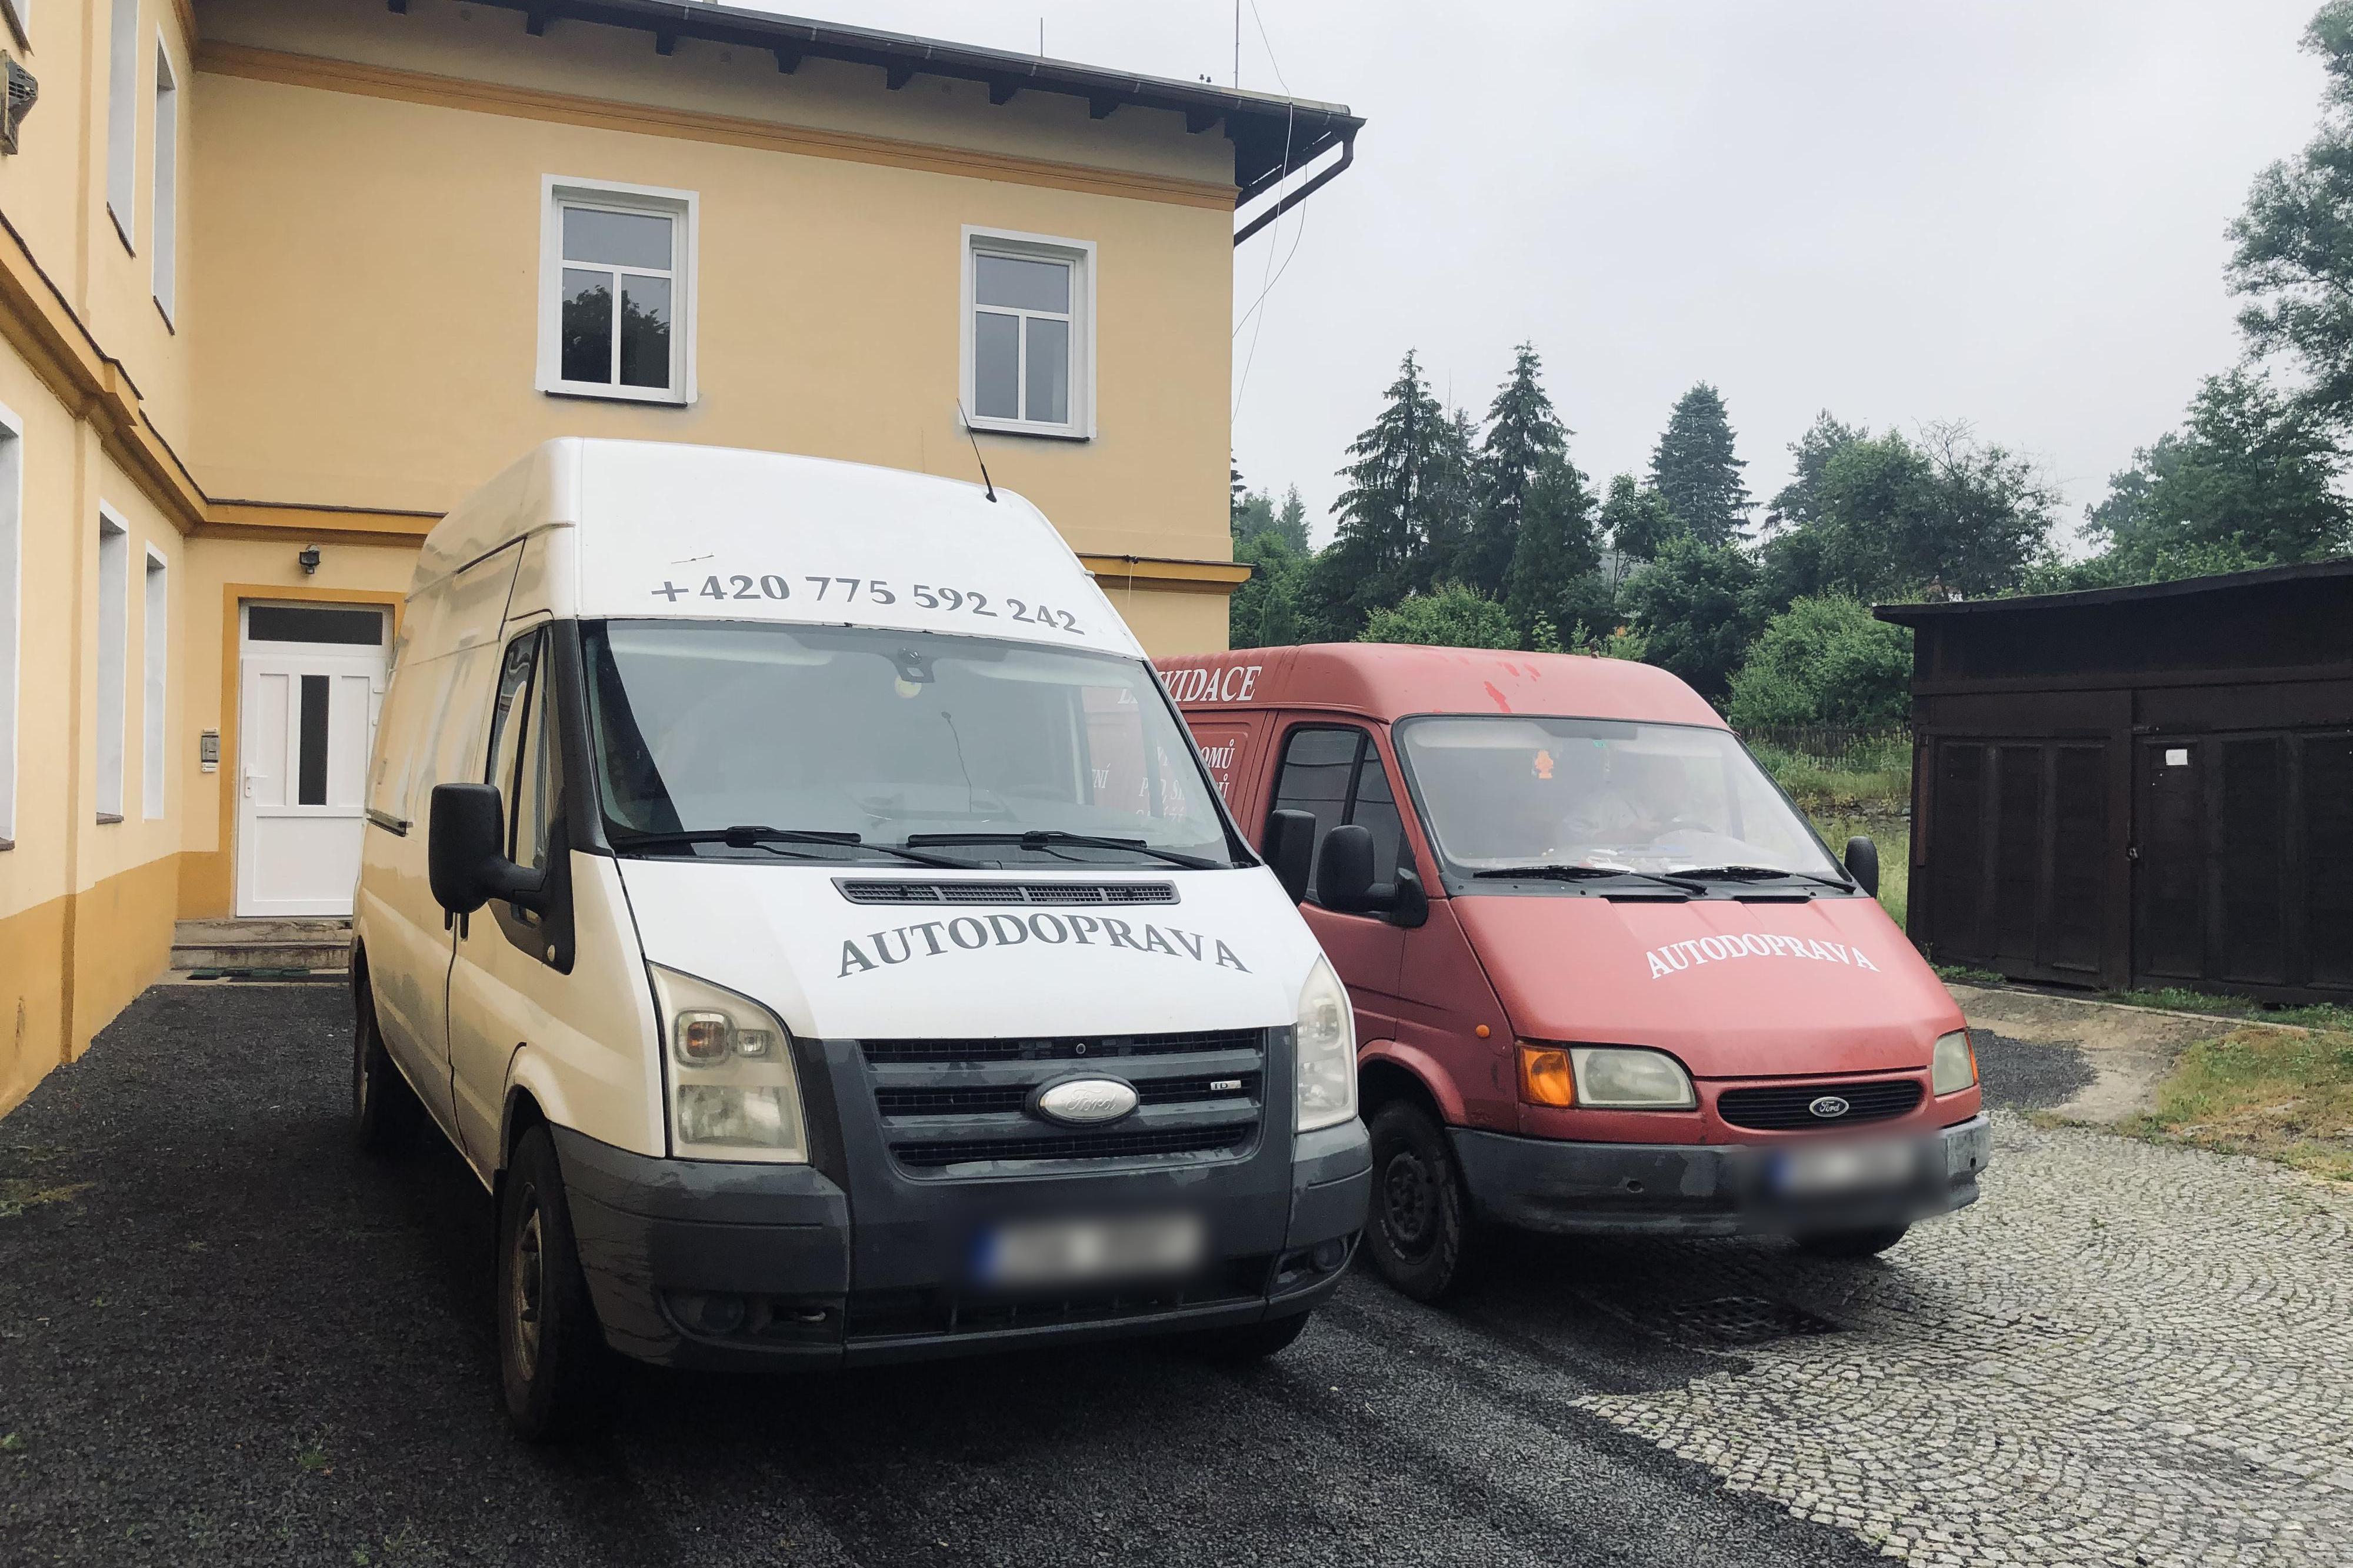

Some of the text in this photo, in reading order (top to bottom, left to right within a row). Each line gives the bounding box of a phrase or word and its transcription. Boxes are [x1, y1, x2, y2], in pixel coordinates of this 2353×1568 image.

[805, 576, 896, 605] 775
[913, 584, 998, 618] 592
[1006, 598, 1085, 635] 242
[1201, 738, 1235, 769] OMŮ
[837, 913, 1252, 979] AUTODOPRAVA
[1646, 933, 1881, 979] AUTODOPRAVA
[1065, 1089, 1117, 1111] Ford
[1819, 1101, 1840, 1113] Ford
